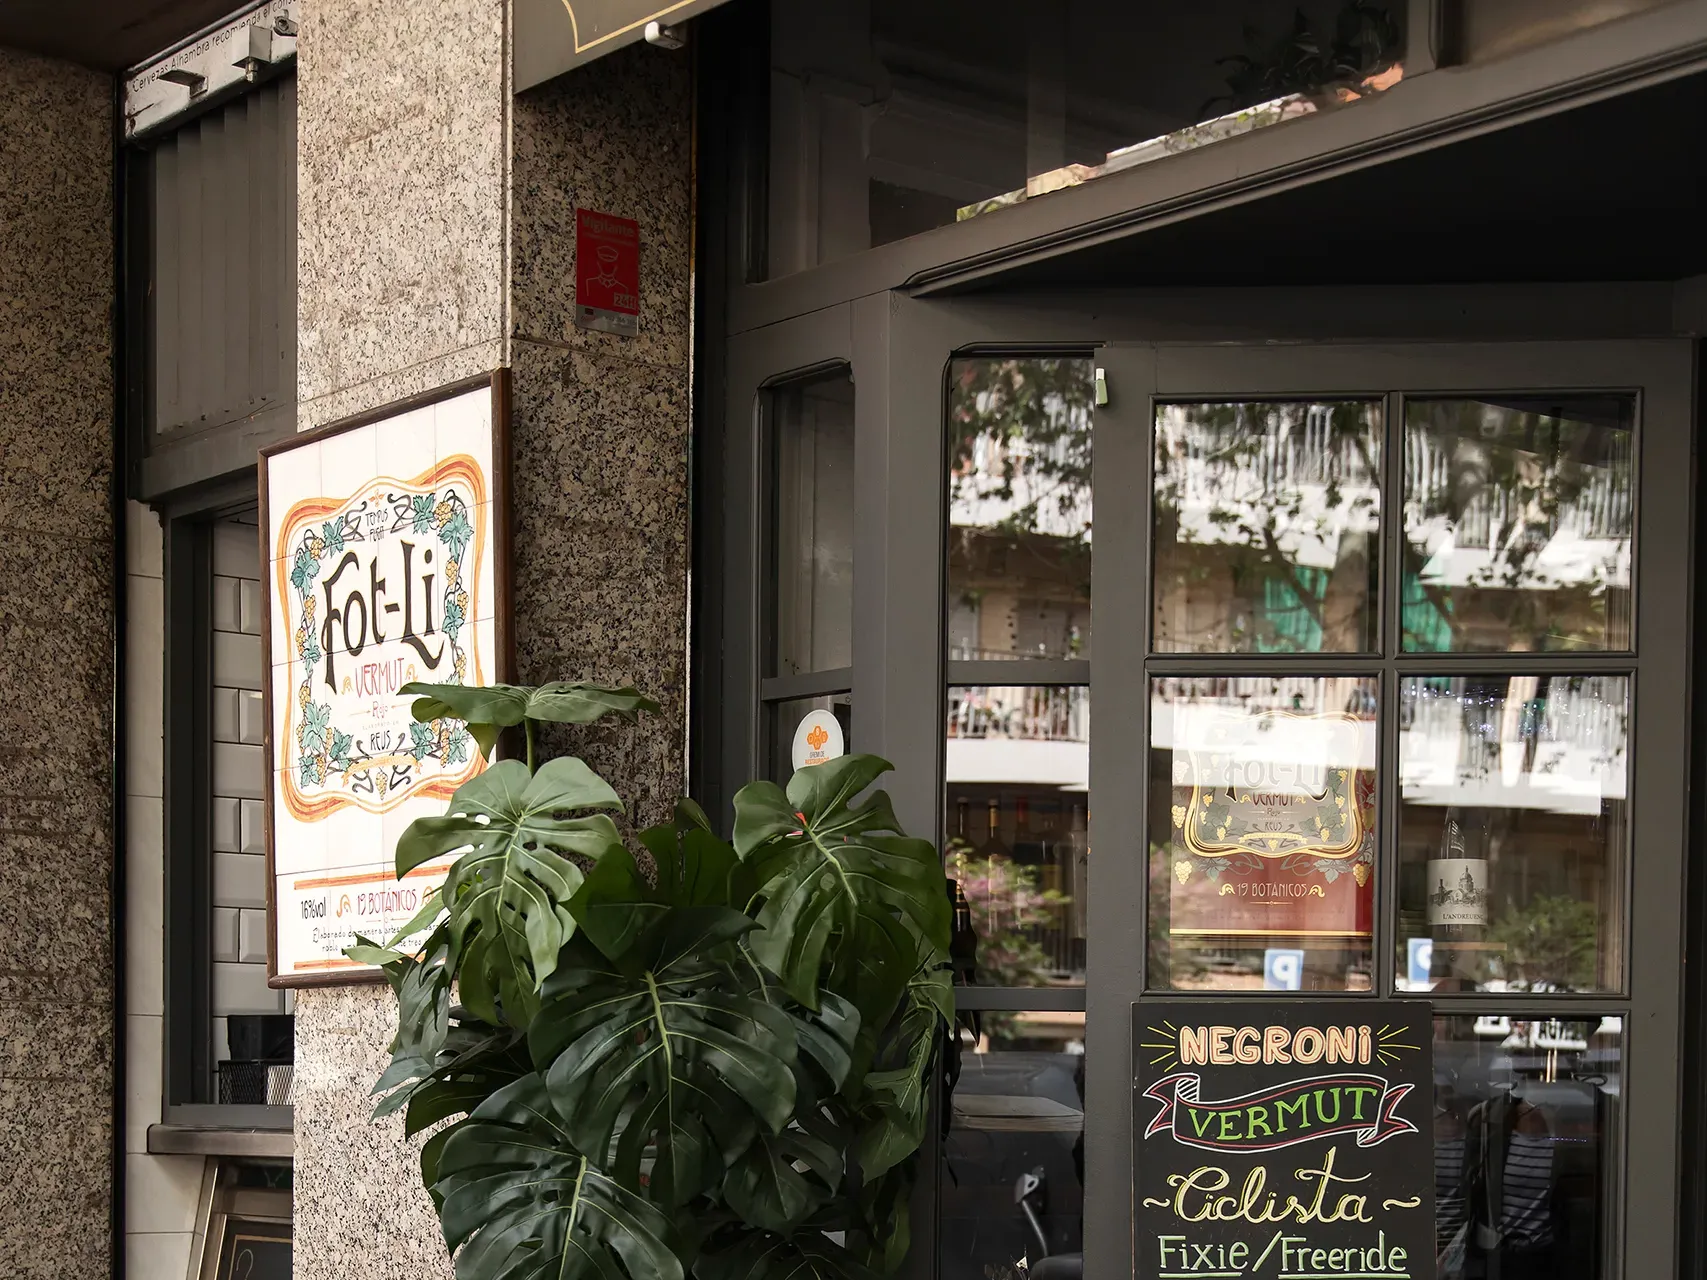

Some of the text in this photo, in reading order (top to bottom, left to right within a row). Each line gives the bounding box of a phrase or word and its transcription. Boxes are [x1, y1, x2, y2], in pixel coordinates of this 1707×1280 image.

[132, 64, 168, 92] Cervezas
[171, 41, 210, 69] Alhambra
[263, 2, 270, 18] el
[582, 214, 635, 237] Vigilante
[615, 294, 636, 309] 24H
[321, 539, 445, 695] Fot-Li
[355, 657, 405, 698] VERMUT
[370, 730, 391, 752] REUS
[1264, 821, 1283, 831] REUS
[368, 887, 417, 915] BOTÁNICOS
[1237, 882, 1307, 897] 19 BOTÁNICOS
[1180, 1025, 1371, 1065] NEGRONi
[1189, 1087, 1378, 1141] VERMUT
[1167, 1146, 1371, 1223] Ciclista
